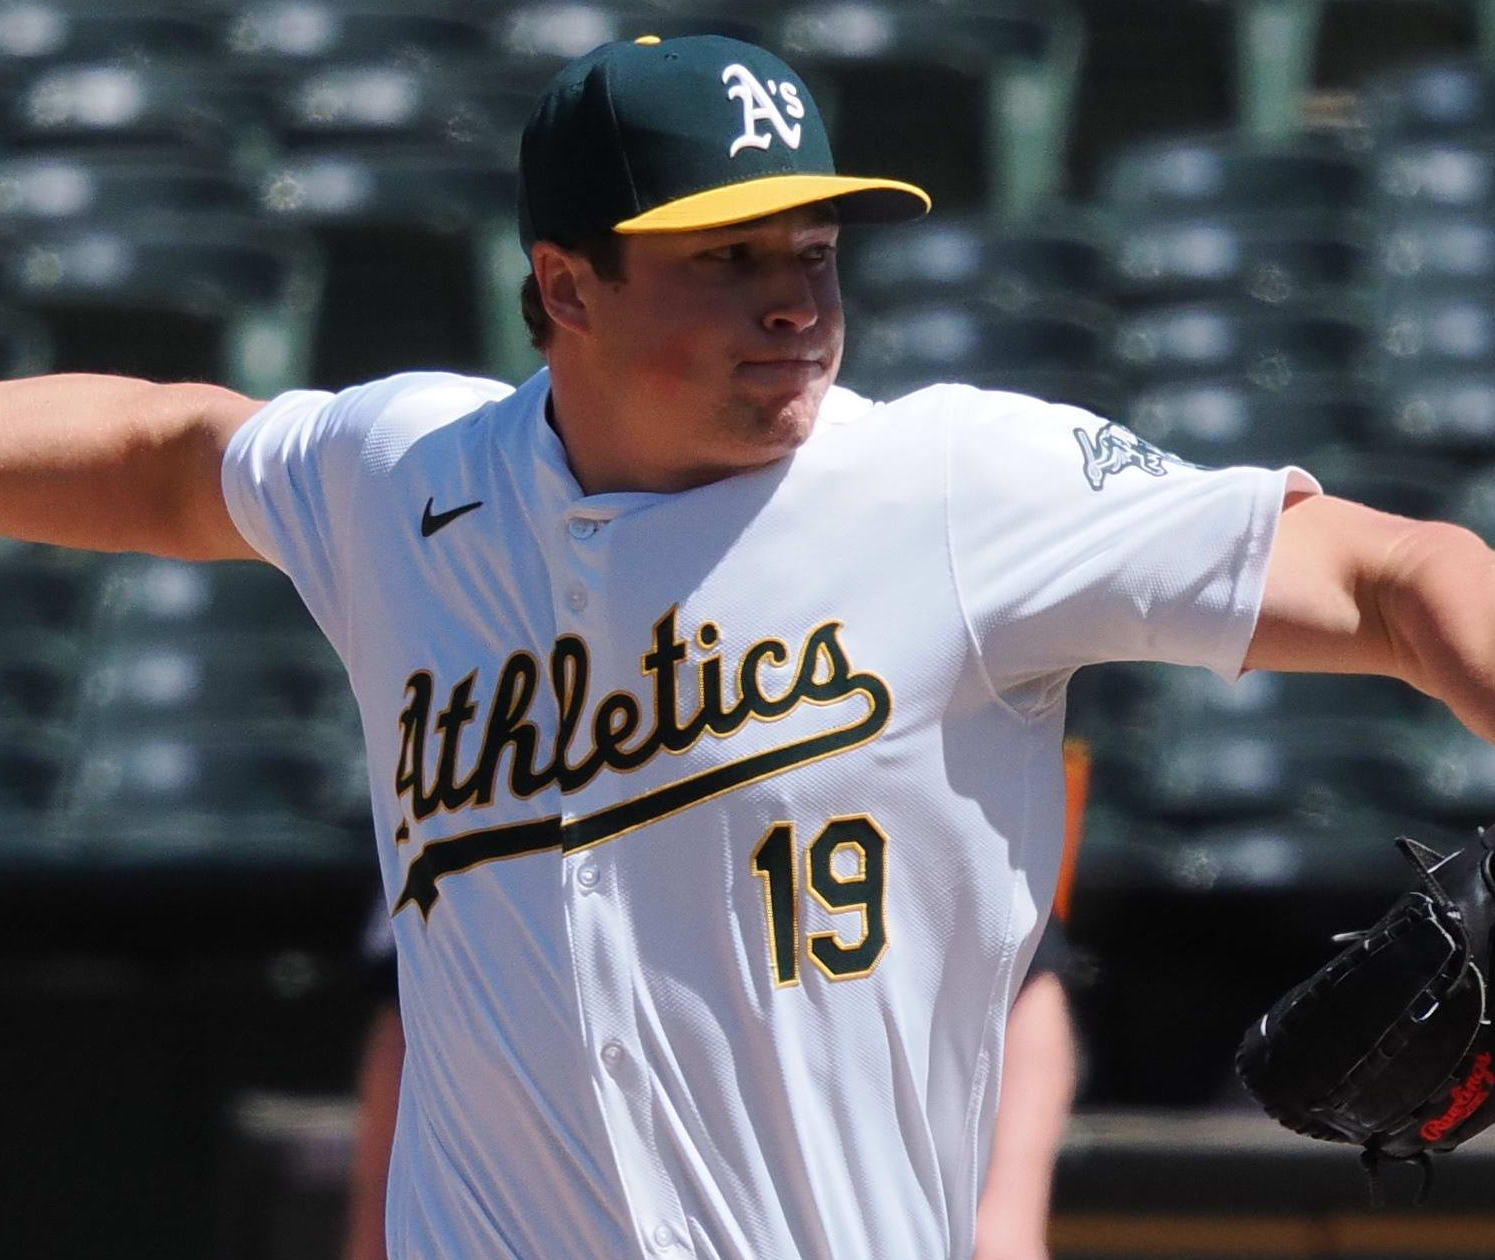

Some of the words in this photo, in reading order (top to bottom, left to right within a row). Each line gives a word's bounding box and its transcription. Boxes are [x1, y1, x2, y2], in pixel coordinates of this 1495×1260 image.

[722, 63, 806, 159] A's
[394, 602, 893, 850] Athletics
[751, 812, 890, 989] 19
